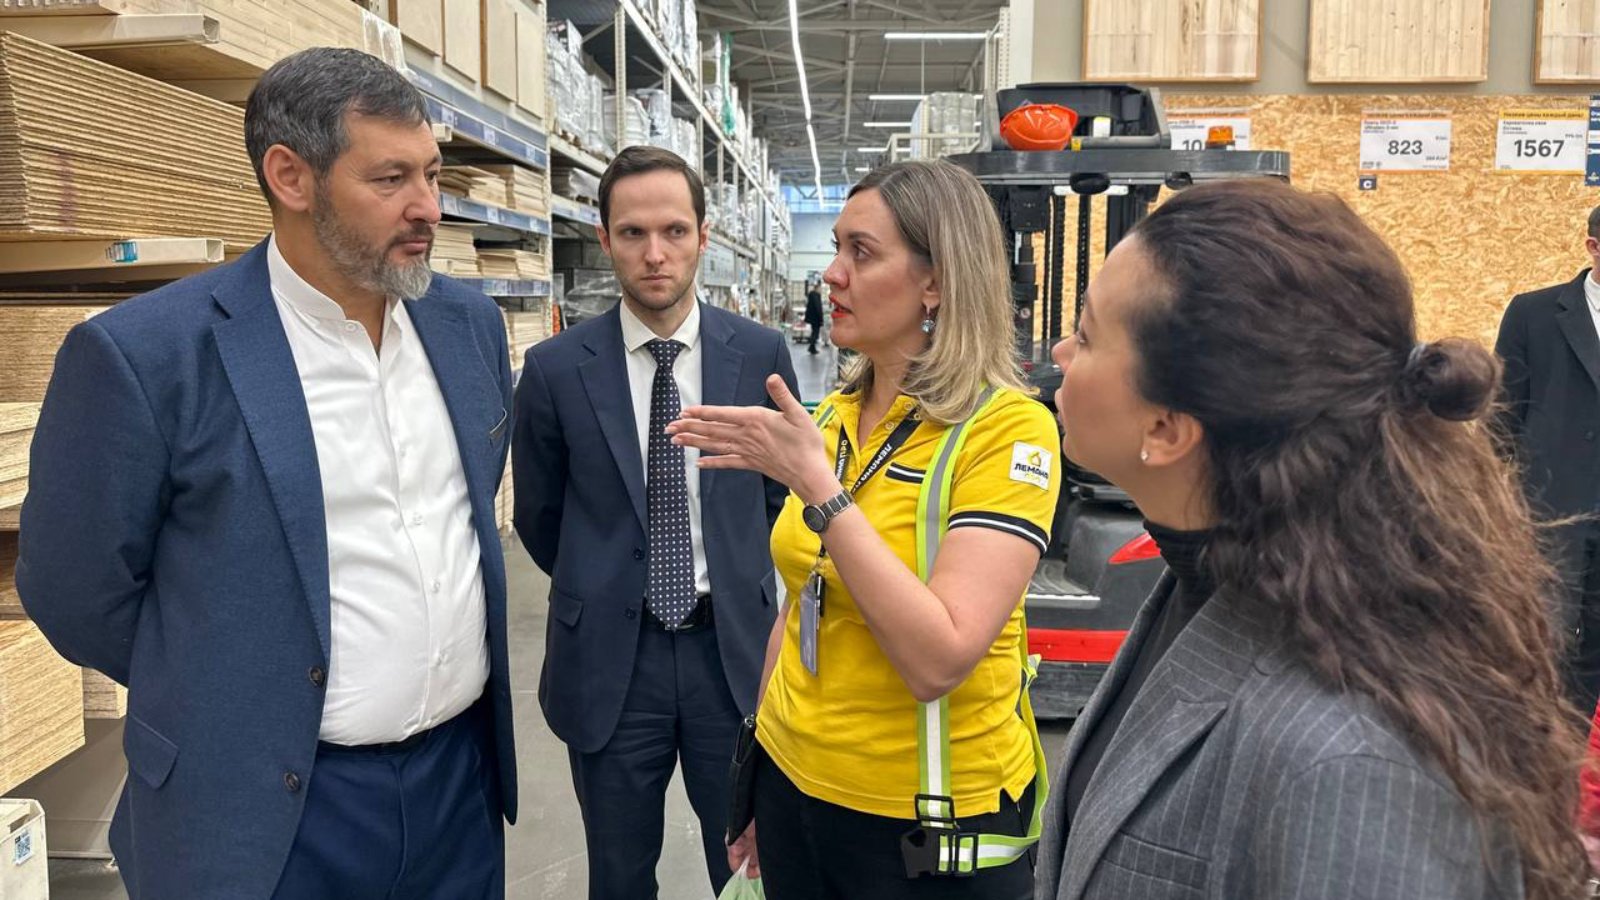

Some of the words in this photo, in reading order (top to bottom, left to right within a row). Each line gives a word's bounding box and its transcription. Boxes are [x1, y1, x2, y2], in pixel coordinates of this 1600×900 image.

[1388, 140, 1423, 155] 823
[1514, 139, 1565, 157] 1567
[1014, 463, 1049, 479] ЛЕМАНА
